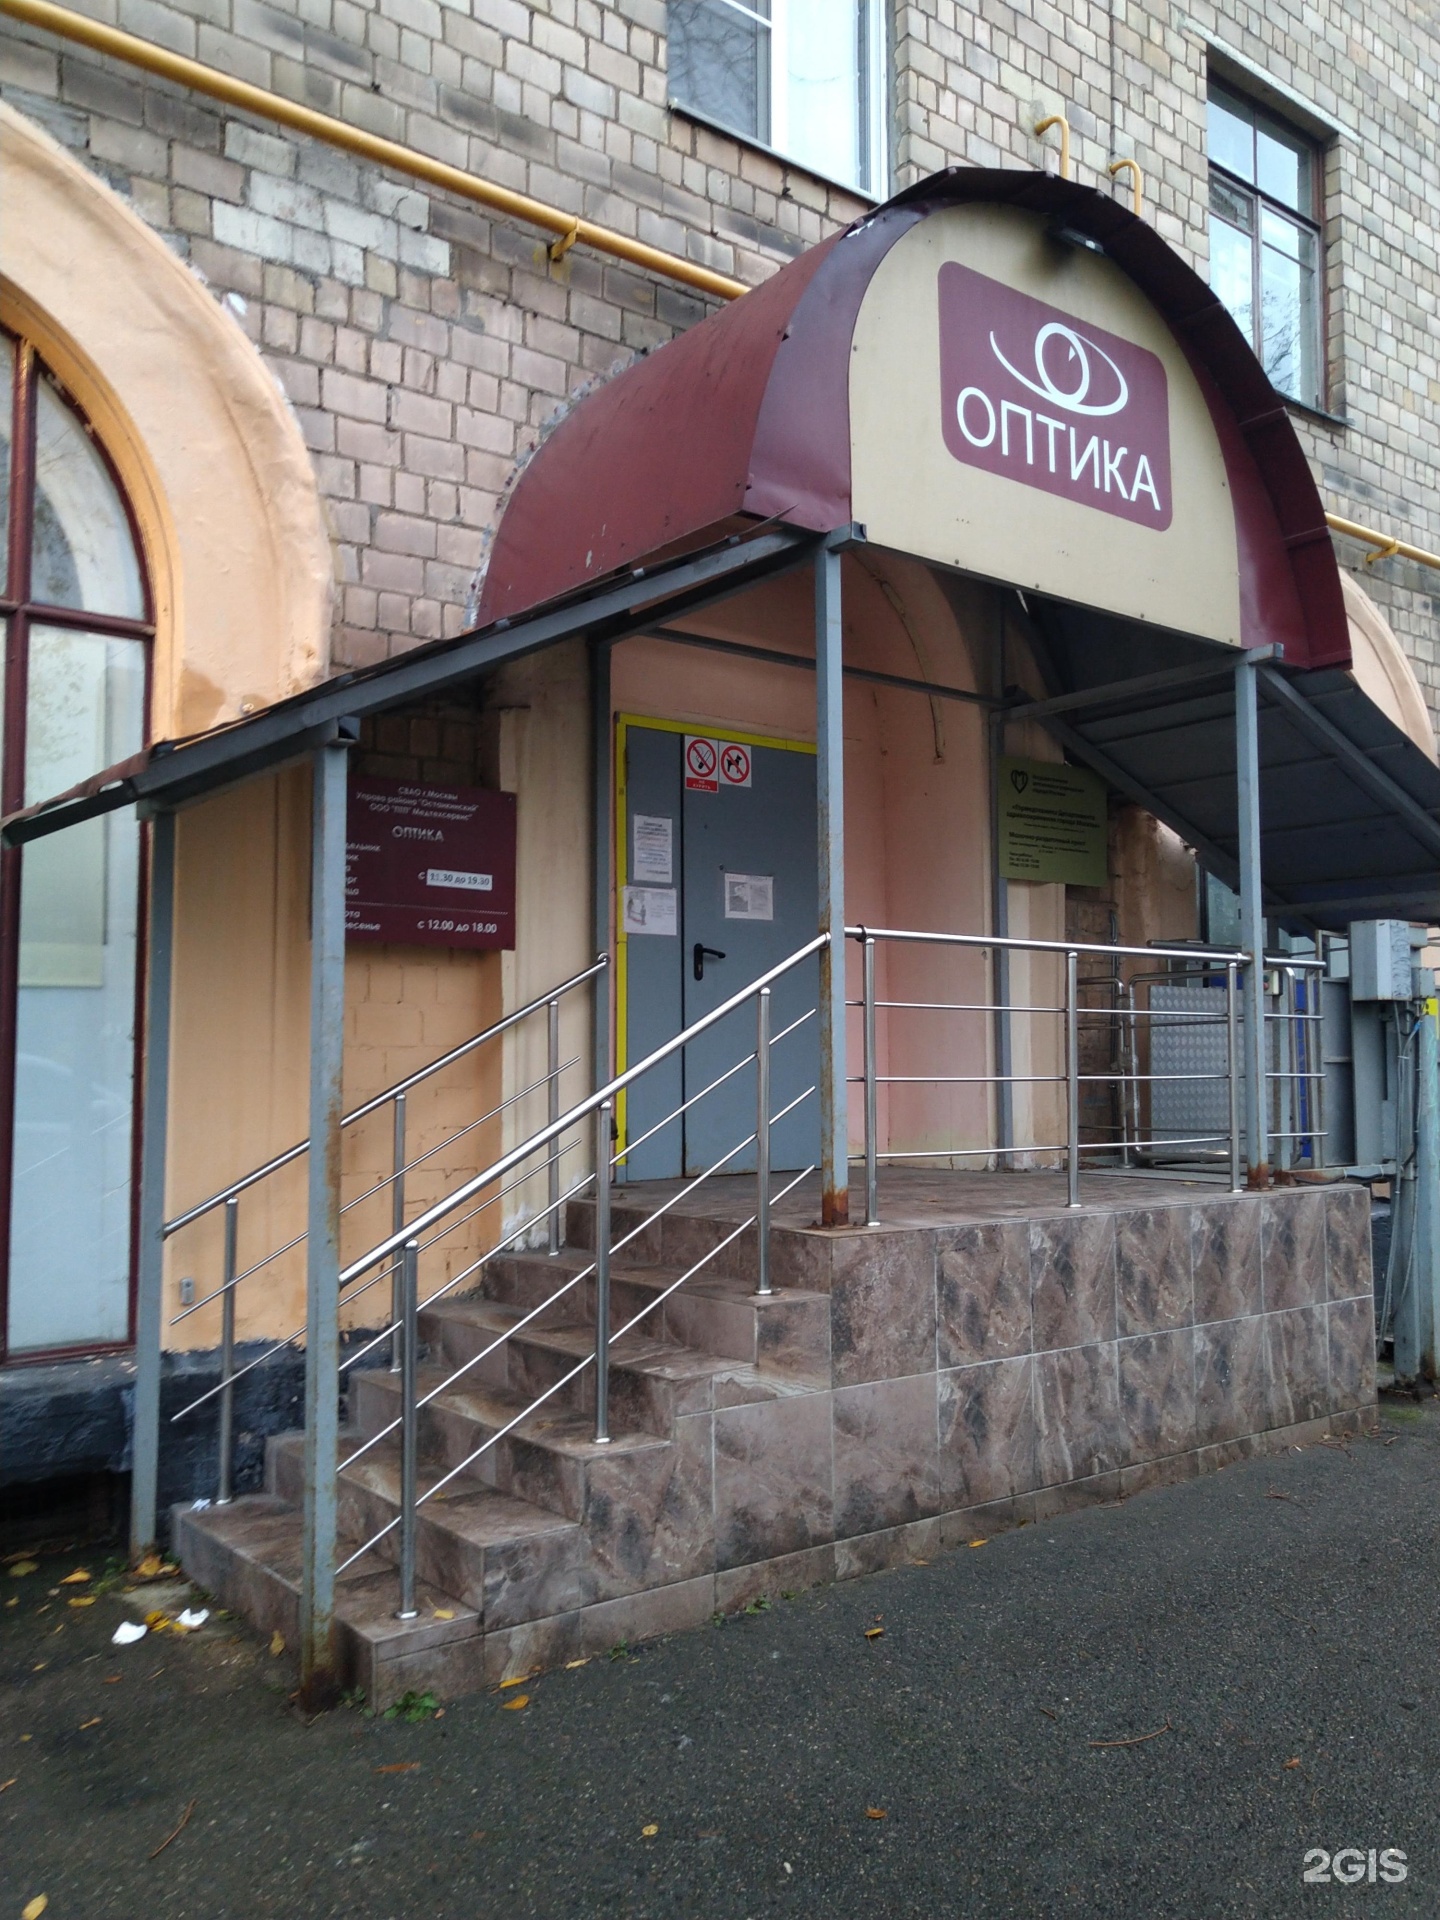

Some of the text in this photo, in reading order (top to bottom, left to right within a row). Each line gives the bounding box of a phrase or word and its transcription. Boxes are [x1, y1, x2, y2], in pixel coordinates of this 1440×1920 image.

[957, 387, 1161, 511] ОПТИКА
[369, 802, 391, 813] ООО
[387, 796, 418, 807] района
[391, 825, 445, 842] ОПТИКА
[454, 876, 466, 886] до
[467, 875, 491, 887] 19.30
[427, 918, 454, 932] 12.00
[454, 923, 470, 933] до
[471, 921, 498, 935] 18.00
